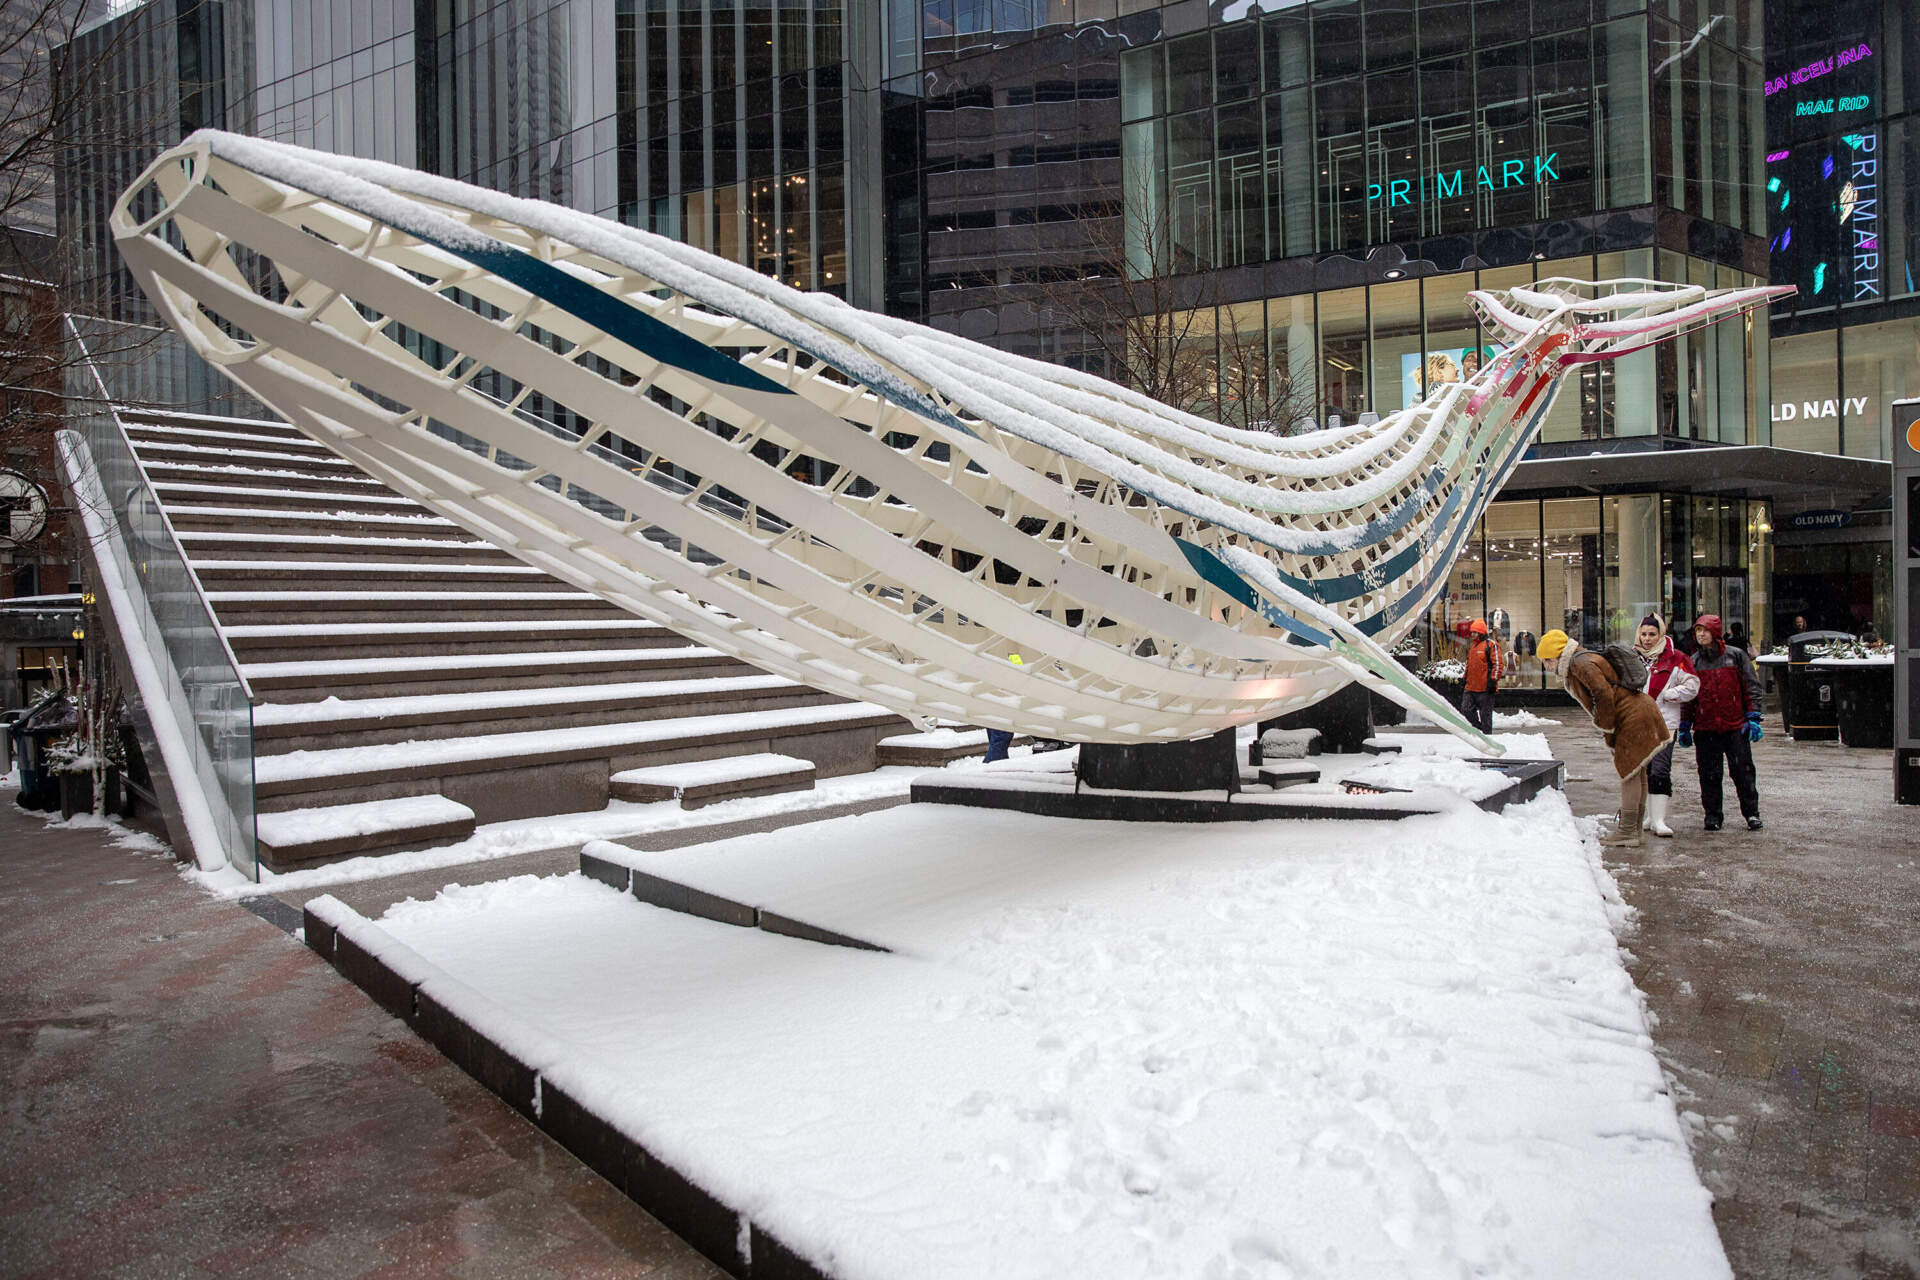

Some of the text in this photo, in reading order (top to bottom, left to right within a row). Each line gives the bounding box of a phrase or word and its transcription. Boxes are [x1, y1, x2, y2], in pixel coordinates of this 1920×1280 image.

[1368, 152, 1560, 207] PRIMARK
[1852, 134, 1879, 299] PRIMARK
[1771, 397, 1868, 422] LD NAVY
[1795, 513, 1843, 526] OLD NAVY
[1461, 571, 1475, 579] fun
[1461, 592, 1483, 601] famil
